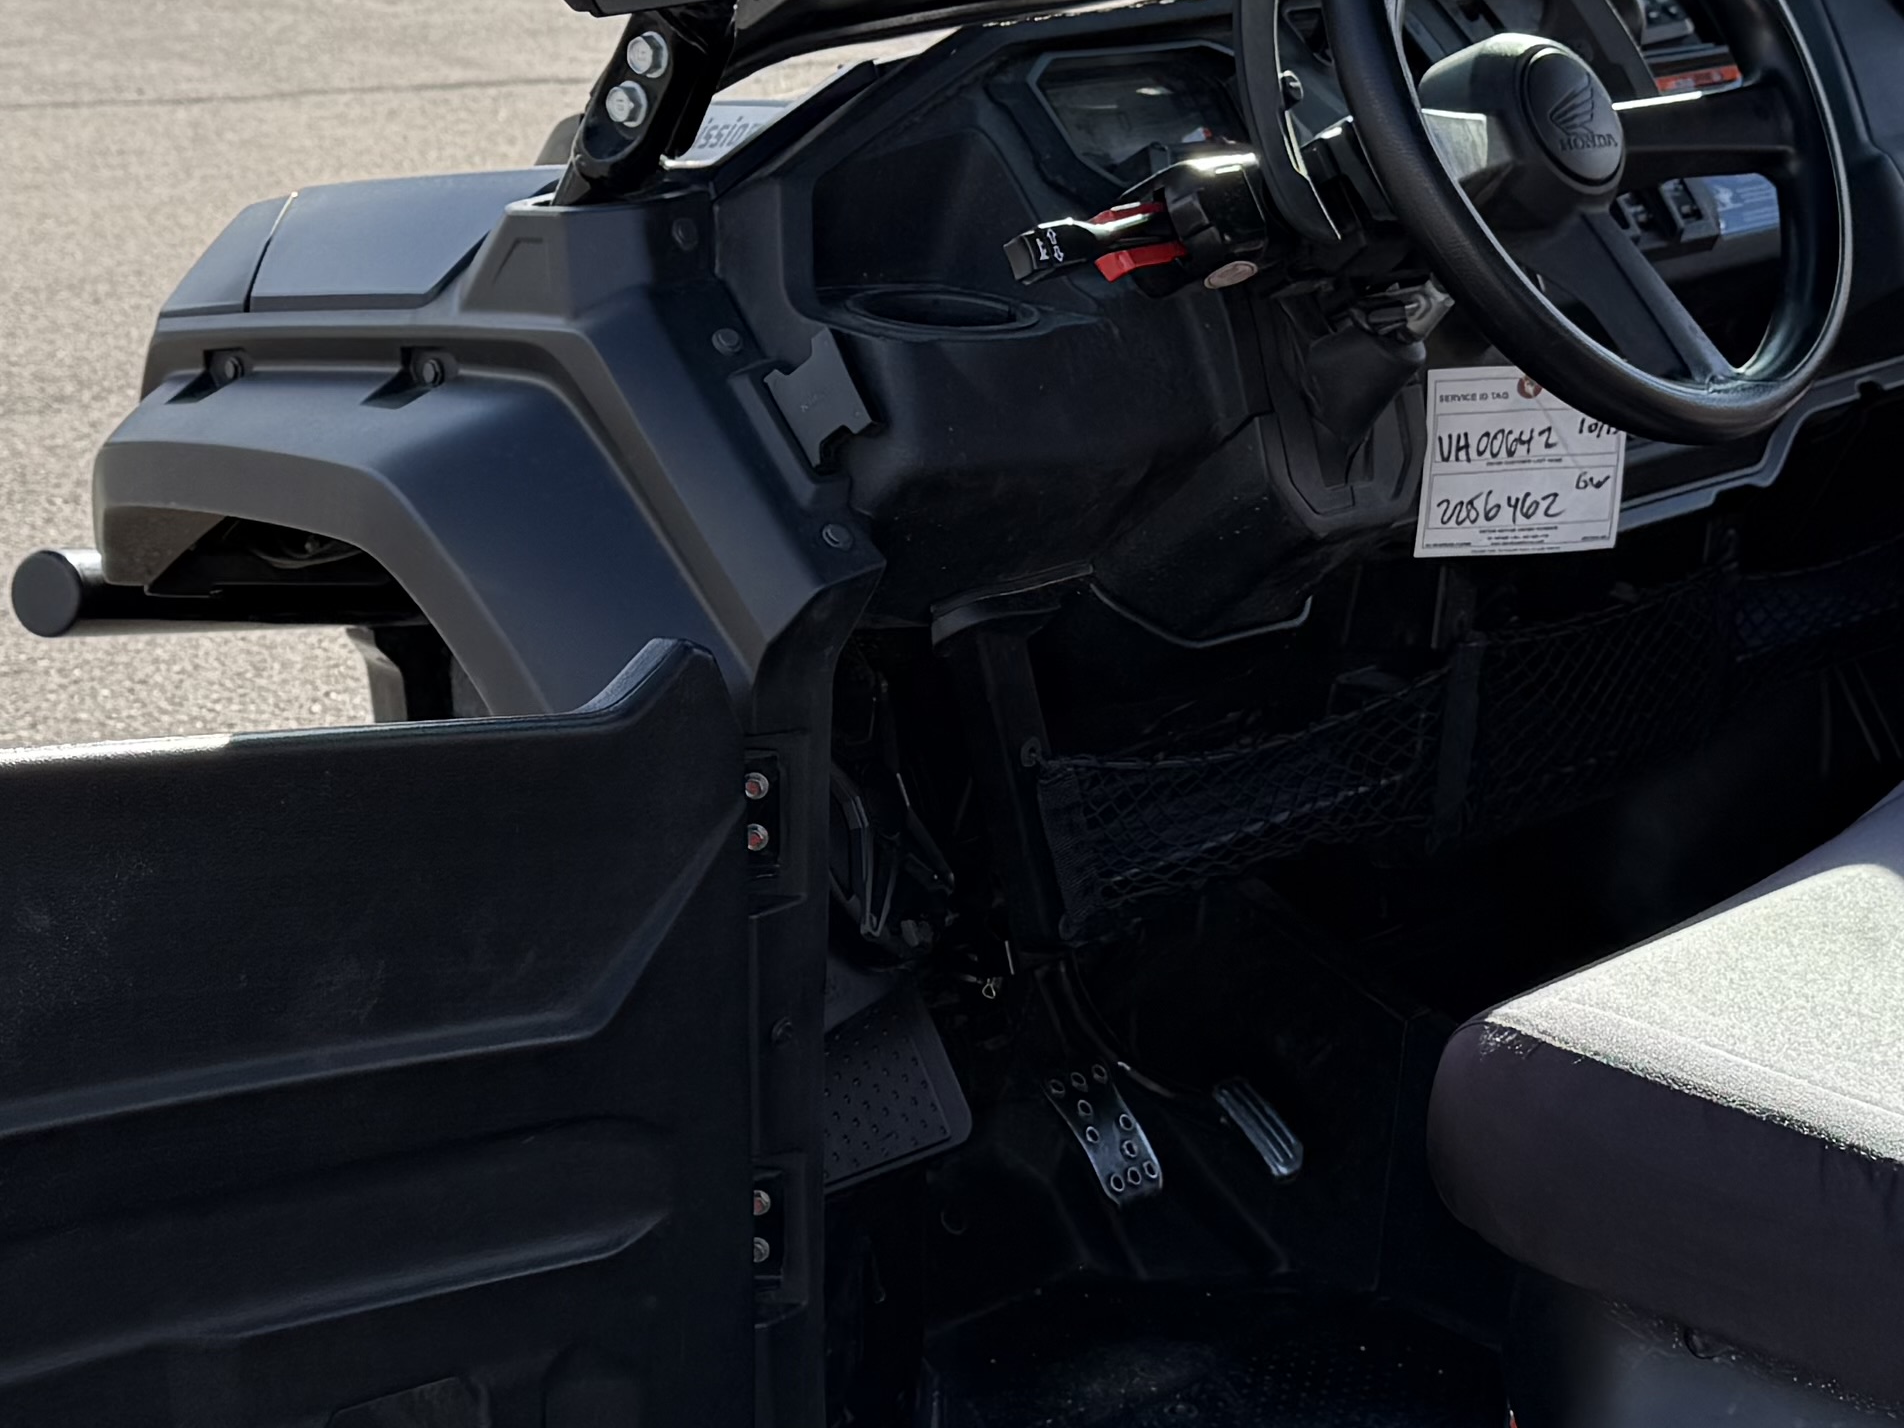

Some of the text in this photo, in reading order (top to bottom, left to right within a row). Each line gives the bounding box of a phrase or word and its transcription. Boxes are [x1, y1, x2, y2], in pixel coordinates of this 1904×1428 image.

[1559, 133, 1618, 152] HONDA
[1439, 391, 1509, 403] SERVICE ID TAG
